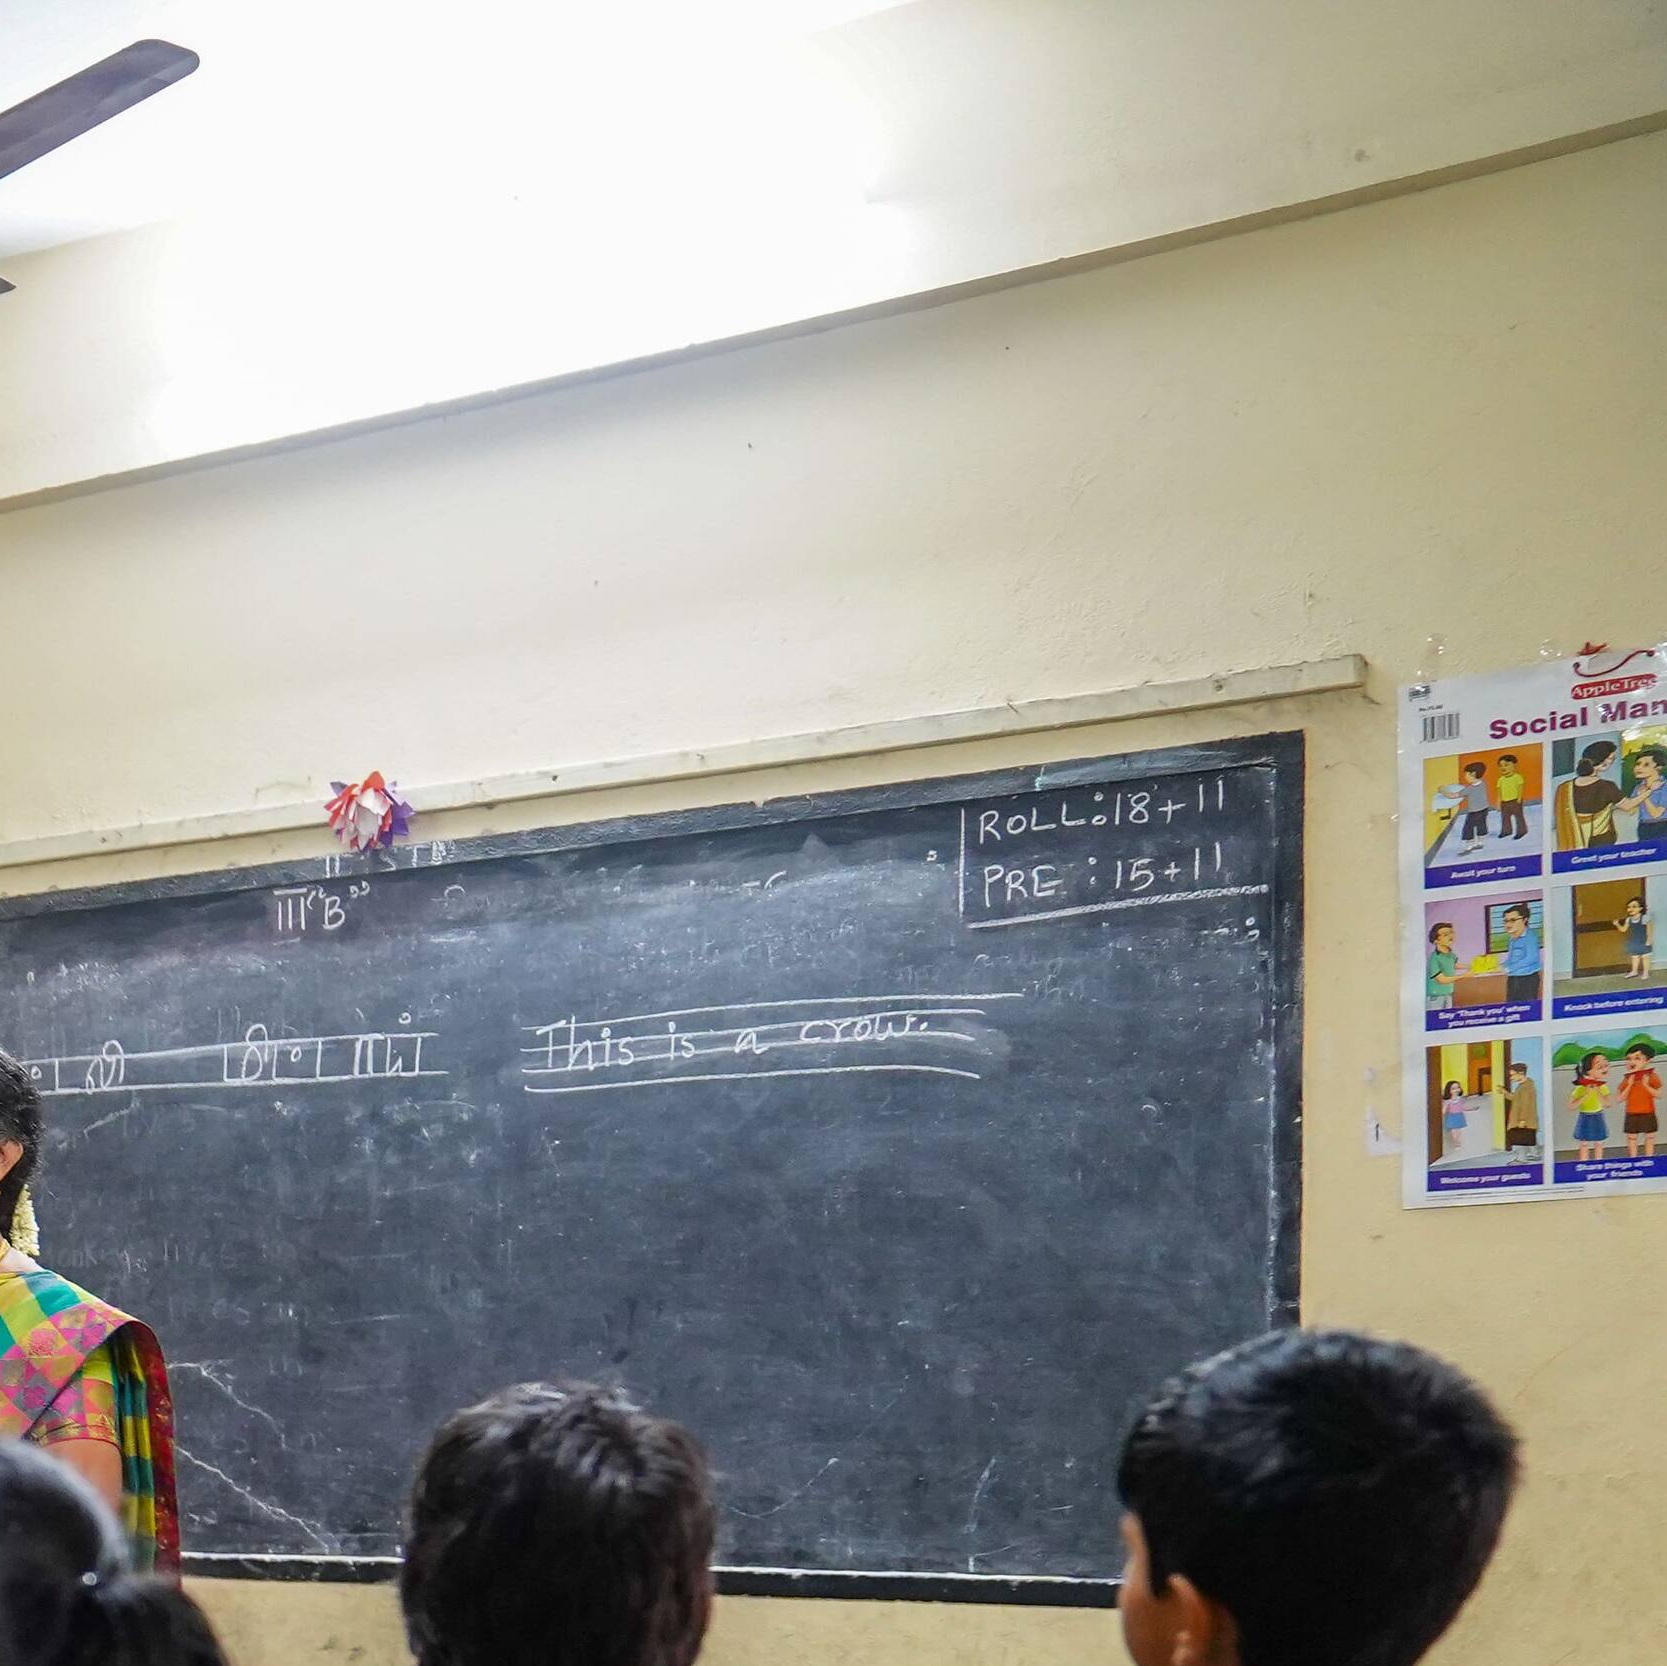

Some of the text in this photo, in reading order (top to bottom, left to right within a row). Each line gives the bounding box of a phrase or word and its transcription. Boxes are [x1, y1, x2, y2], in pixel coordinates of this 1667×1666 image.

[1489, 706, 1588, 741] Social
[983, 864, 1065, 908] PRE
[535, 1014, 635, 1071] This
[665, 1020, 697, 1061] is
[732, 1027, 769, 1055] a
